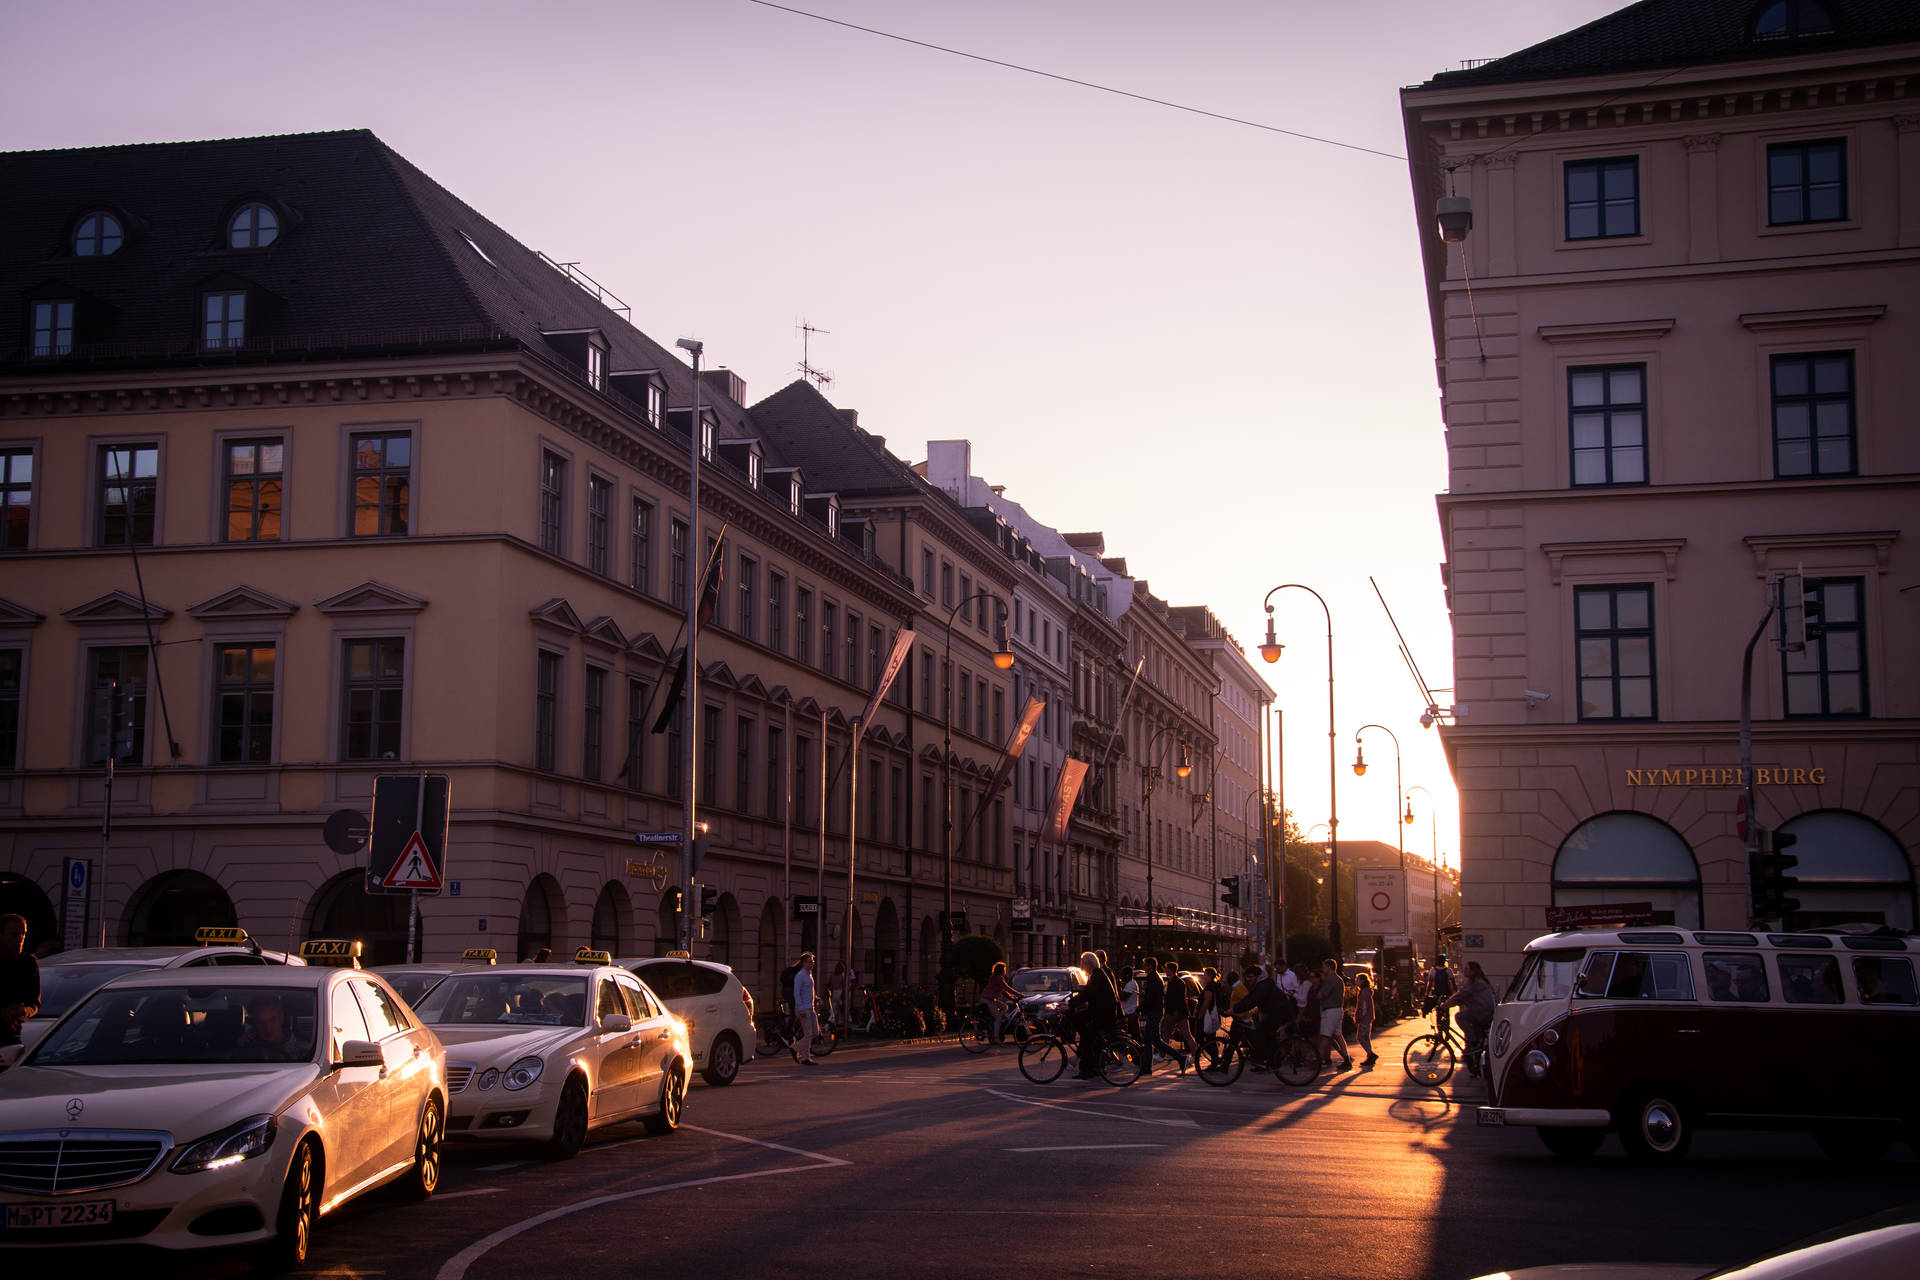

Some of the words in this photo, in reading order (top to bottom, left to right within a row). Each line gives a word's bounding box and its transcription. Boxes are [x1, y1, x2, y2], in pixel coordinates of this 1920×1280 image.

[203, 929, 233, 938] TAXI
[310, 942, 347, 954] TAXI
[578, 951, 606, 959] TAXI
[61, 1204, 110, 1224] 2234
